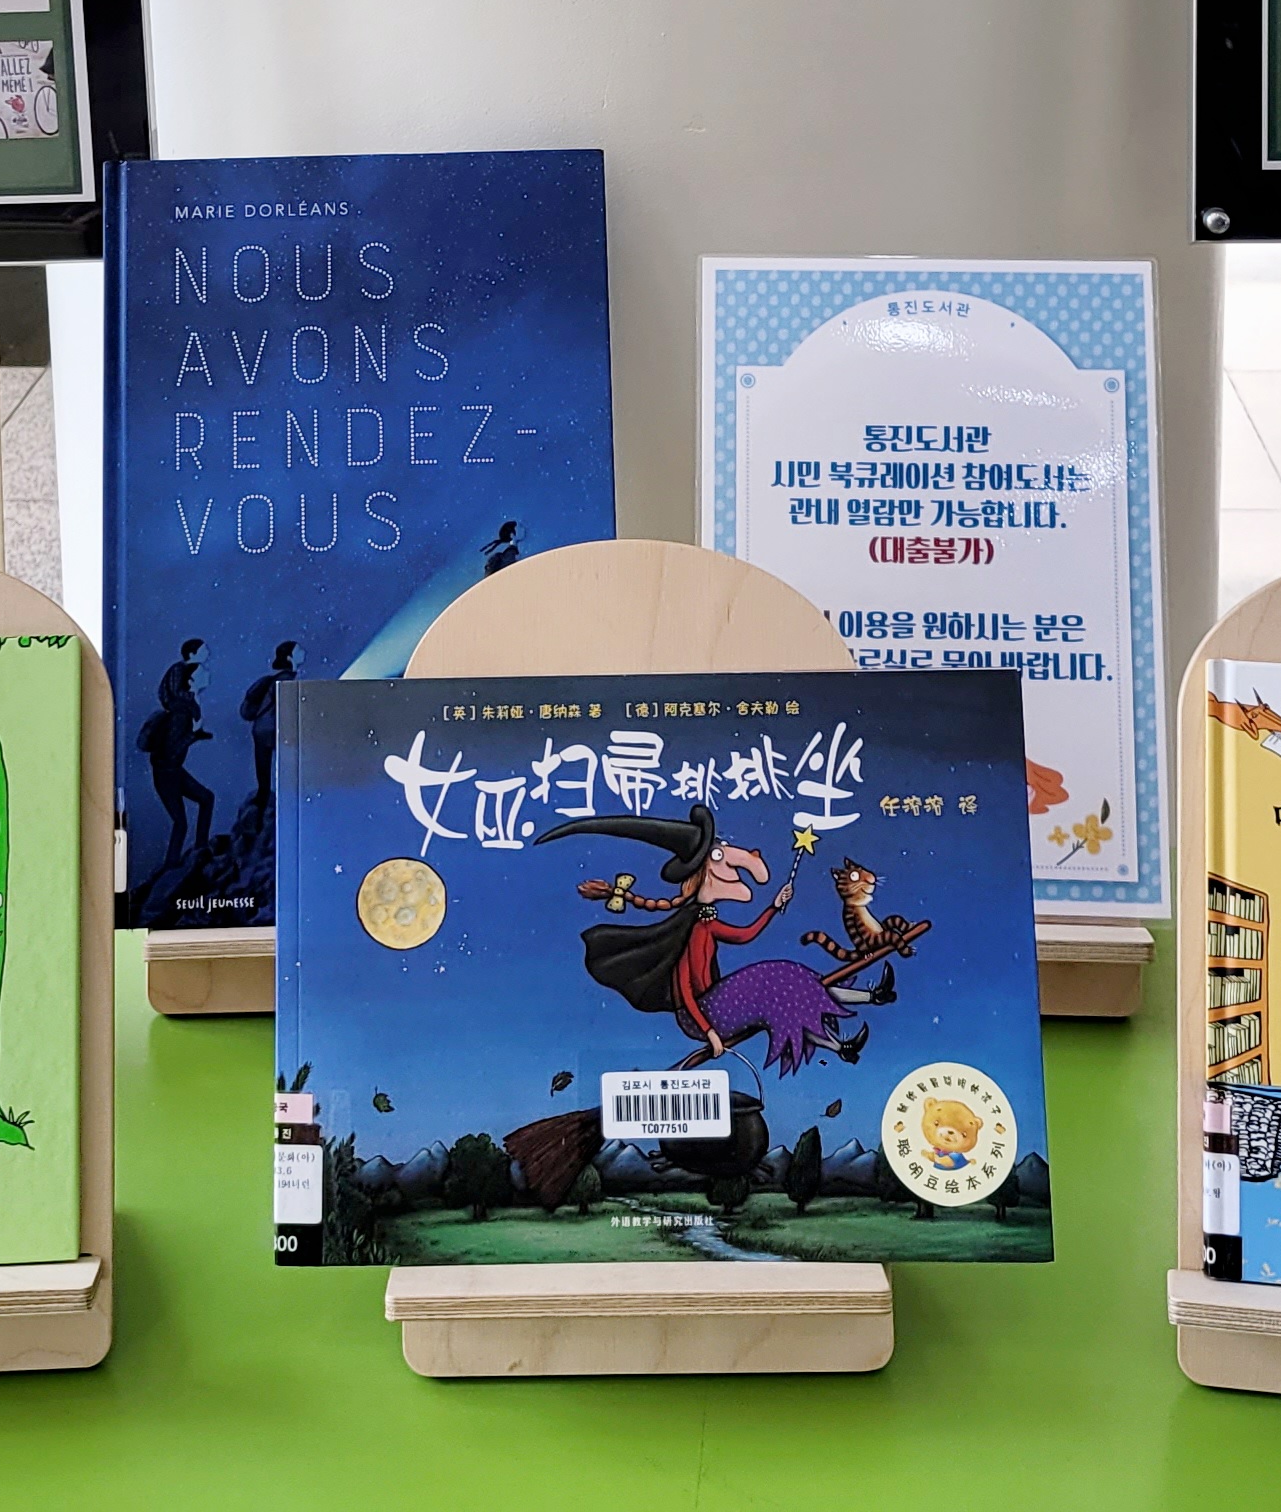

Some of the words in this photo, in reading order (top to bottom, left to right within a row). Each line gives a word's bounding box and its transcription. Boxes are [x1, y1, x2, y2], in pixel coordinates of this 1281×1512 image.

[1, 58, 32, 77] ALLEZ
[175, 205, 235, 220] MARIE
[244, 200, 349, 218] DORLÉANS
[174, 243, 394, 304] NOUS
[887, 300, 971, 317] 통진도서관
[176, 323, 449, 386] AVONS
[175, 404, 538, 470] RENDEZ-
[863, 424, 992, 453] 통진도서관
[771, 461, 821, 488] 시민
[828, 461, 958, 490] 북큐레이션
[961, 463, 1091, 493] 참여도서는
[176, 491, 401, 554] VOUS
[789, 499, 839, 527] 관내
[847, 498, 923, 528] 열람만
[931, 500, 1066, 529] 가능합니다.
[868, 536, 995, 565] (대출불가)
[839, 610, 916, 638] 이용을
[923, 612, 1027, 640] 원하시는
[1033, 614, 1086, 642] 분은
[622, 1080, 651, 1090] 김포시
[660, 1079, 711, 1090] 통진도서관
[642, 1123, 688, 1134] TC077510
